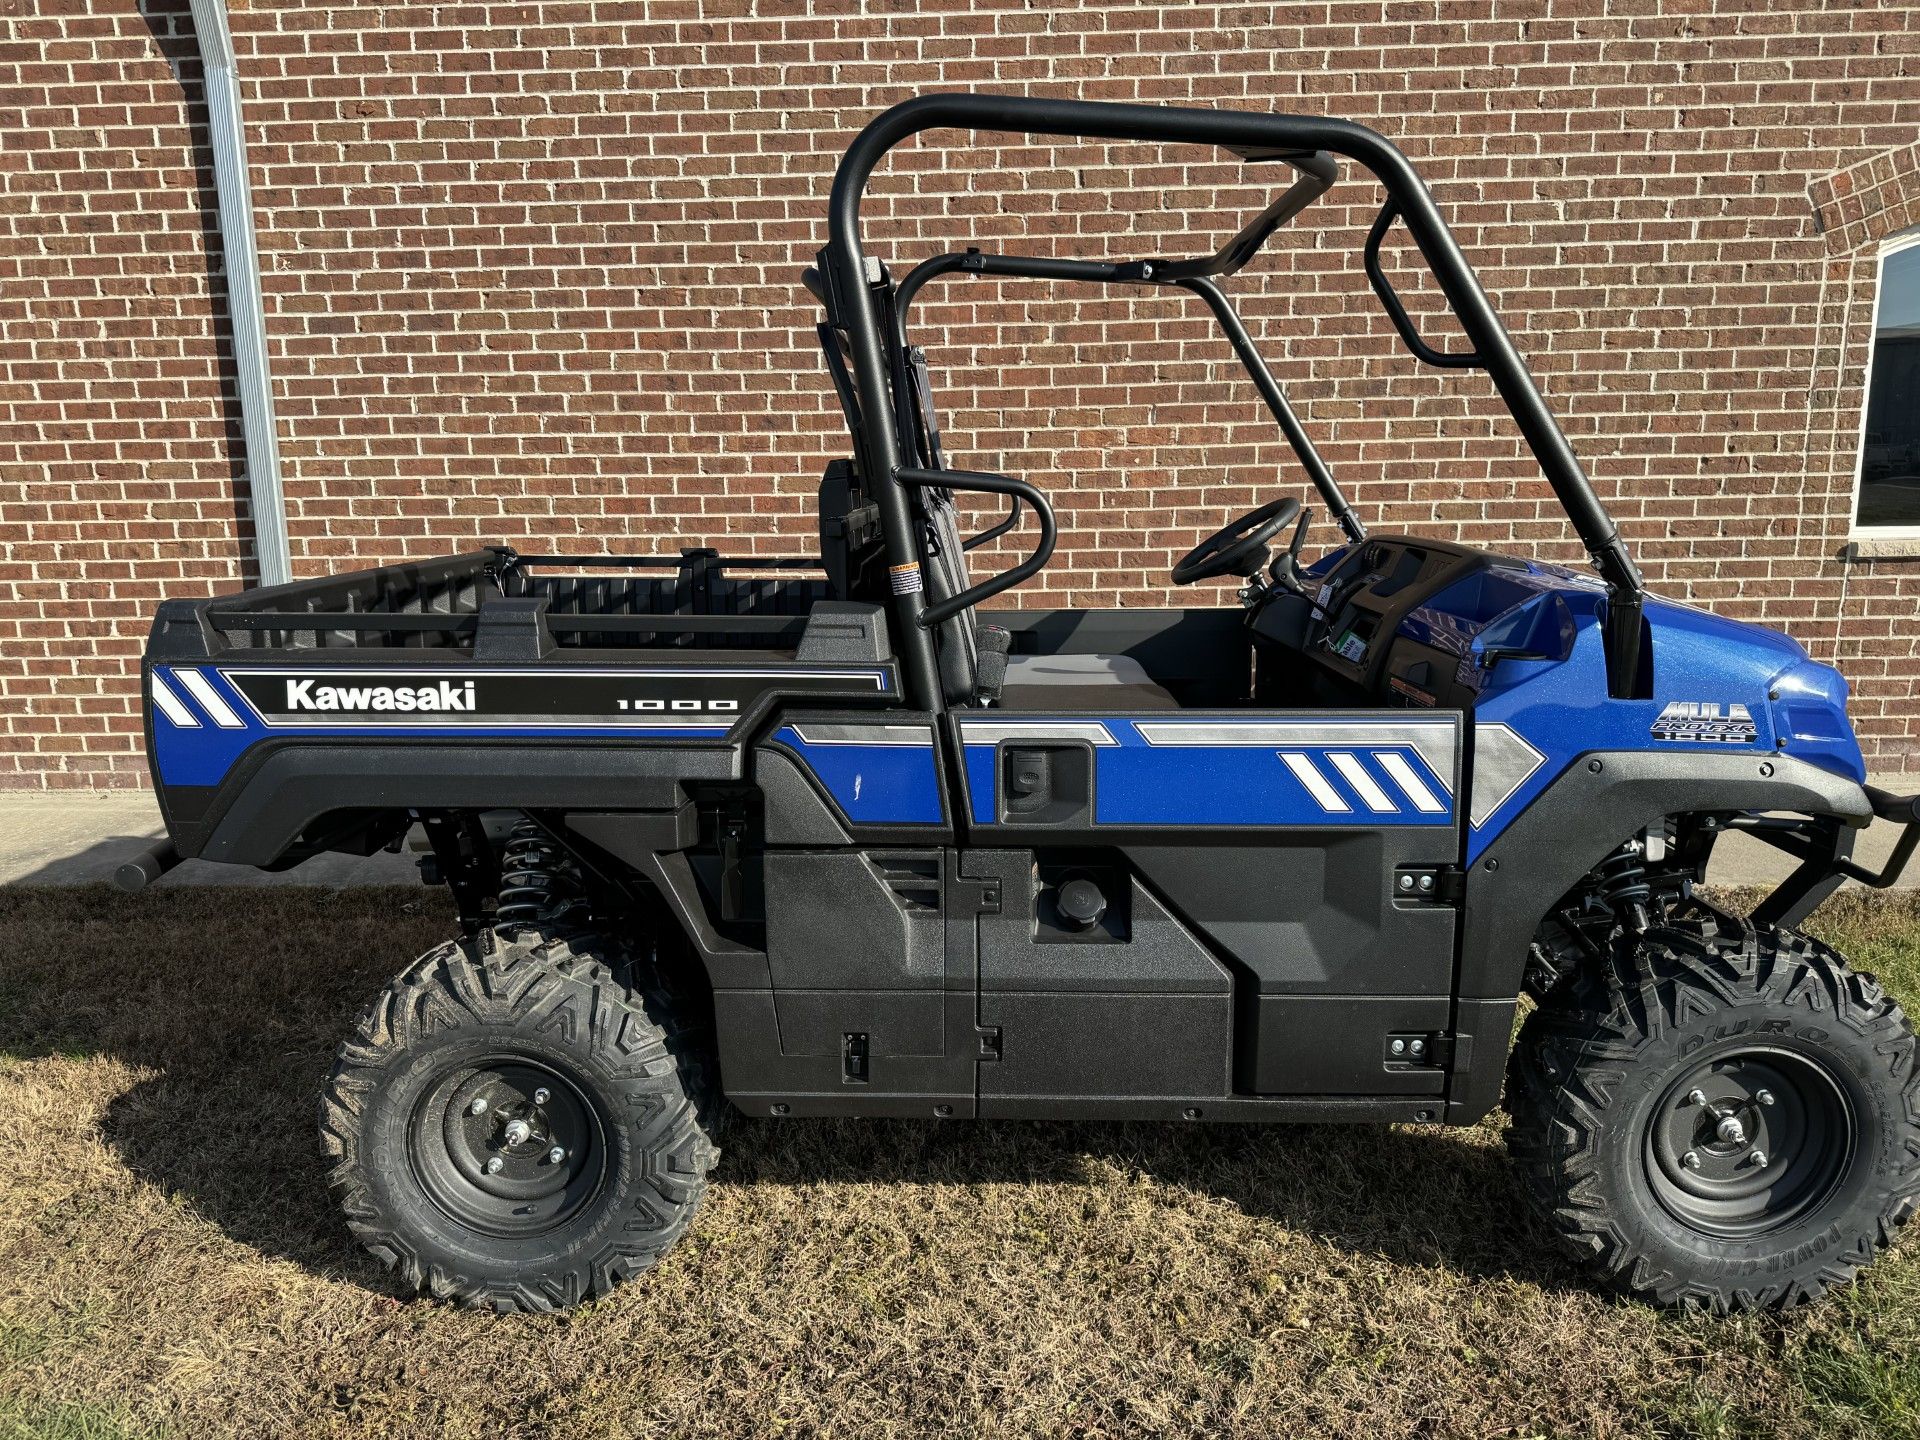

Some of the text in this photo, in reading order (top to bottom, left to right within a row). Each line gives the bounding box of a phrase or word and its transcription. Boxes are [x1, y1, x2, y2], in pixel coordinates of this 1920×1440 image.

[286, 680, 476, 711] Kawasaki
[616, 699, 738, 710] 1000
[1655, 702, 1755, 723] MULE
[1677, 1016, 1830, 1062] DURO
